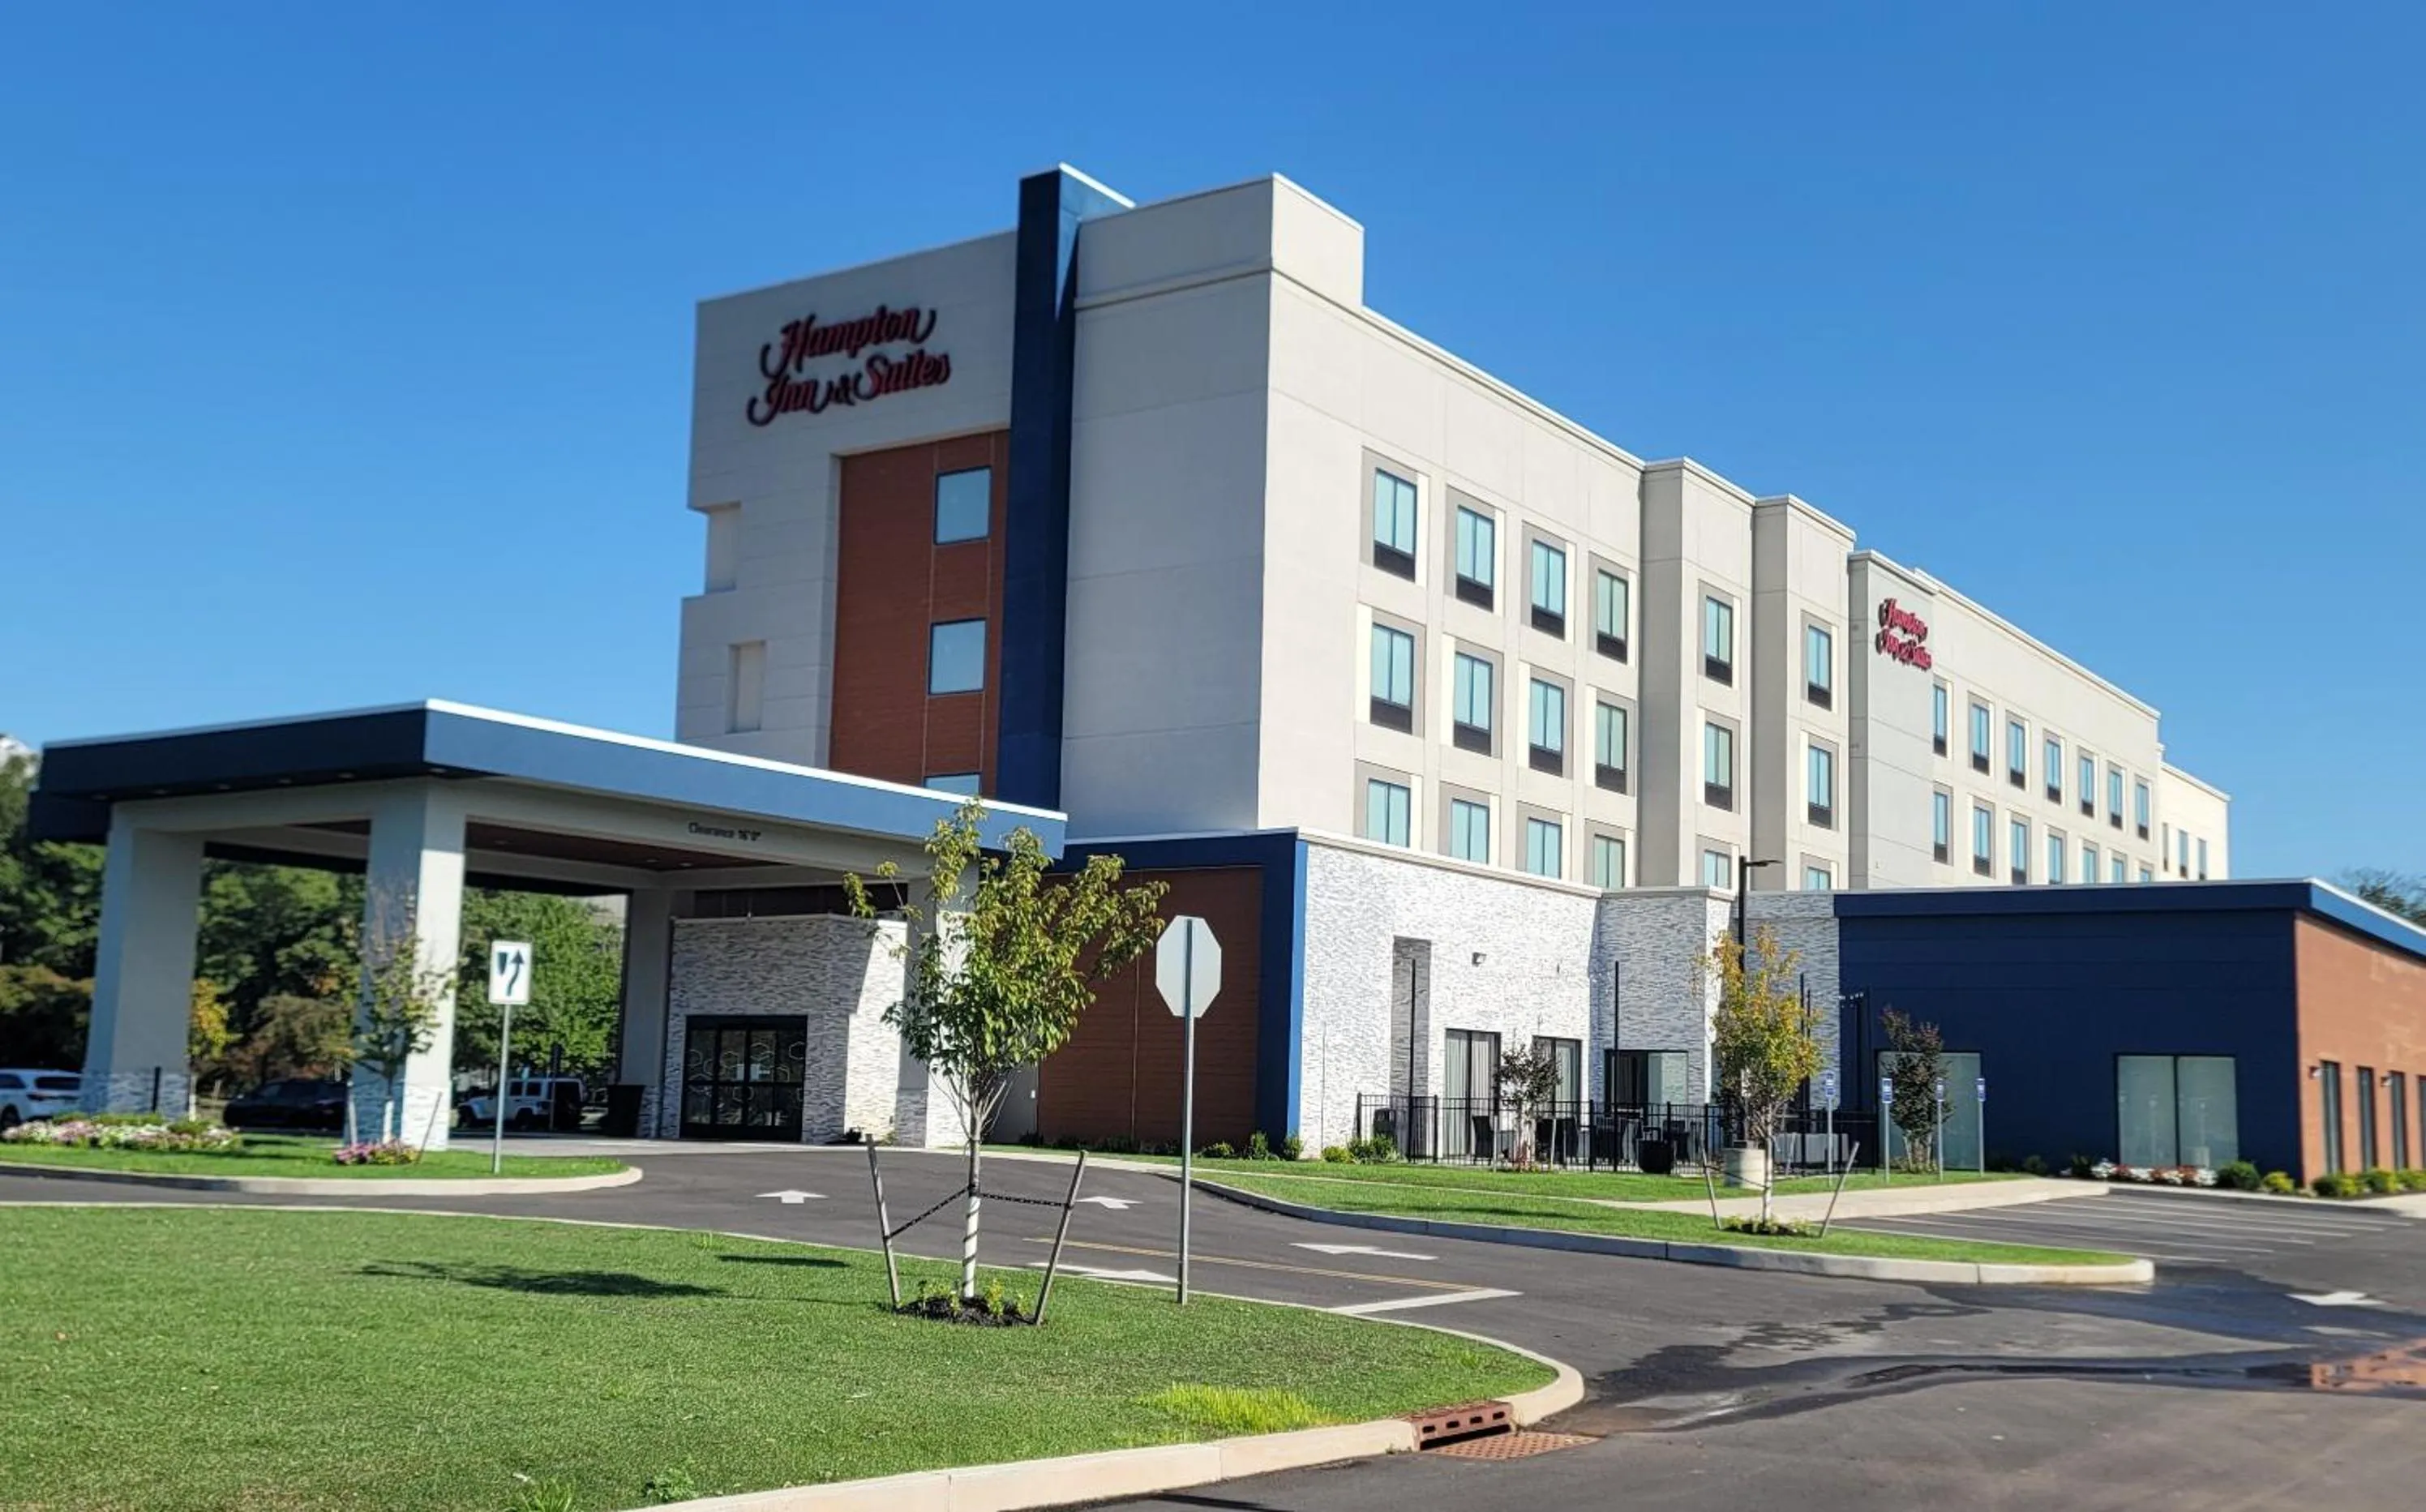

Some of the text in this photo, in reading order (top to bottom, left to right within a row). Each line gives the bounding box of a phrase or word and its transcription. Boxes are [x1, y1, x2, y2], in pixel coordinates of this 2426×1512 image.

[760, 305, 937, 380] Hampton
[746, 374, 834, 427] Inn
[853, 348, 952, 400] Suites
